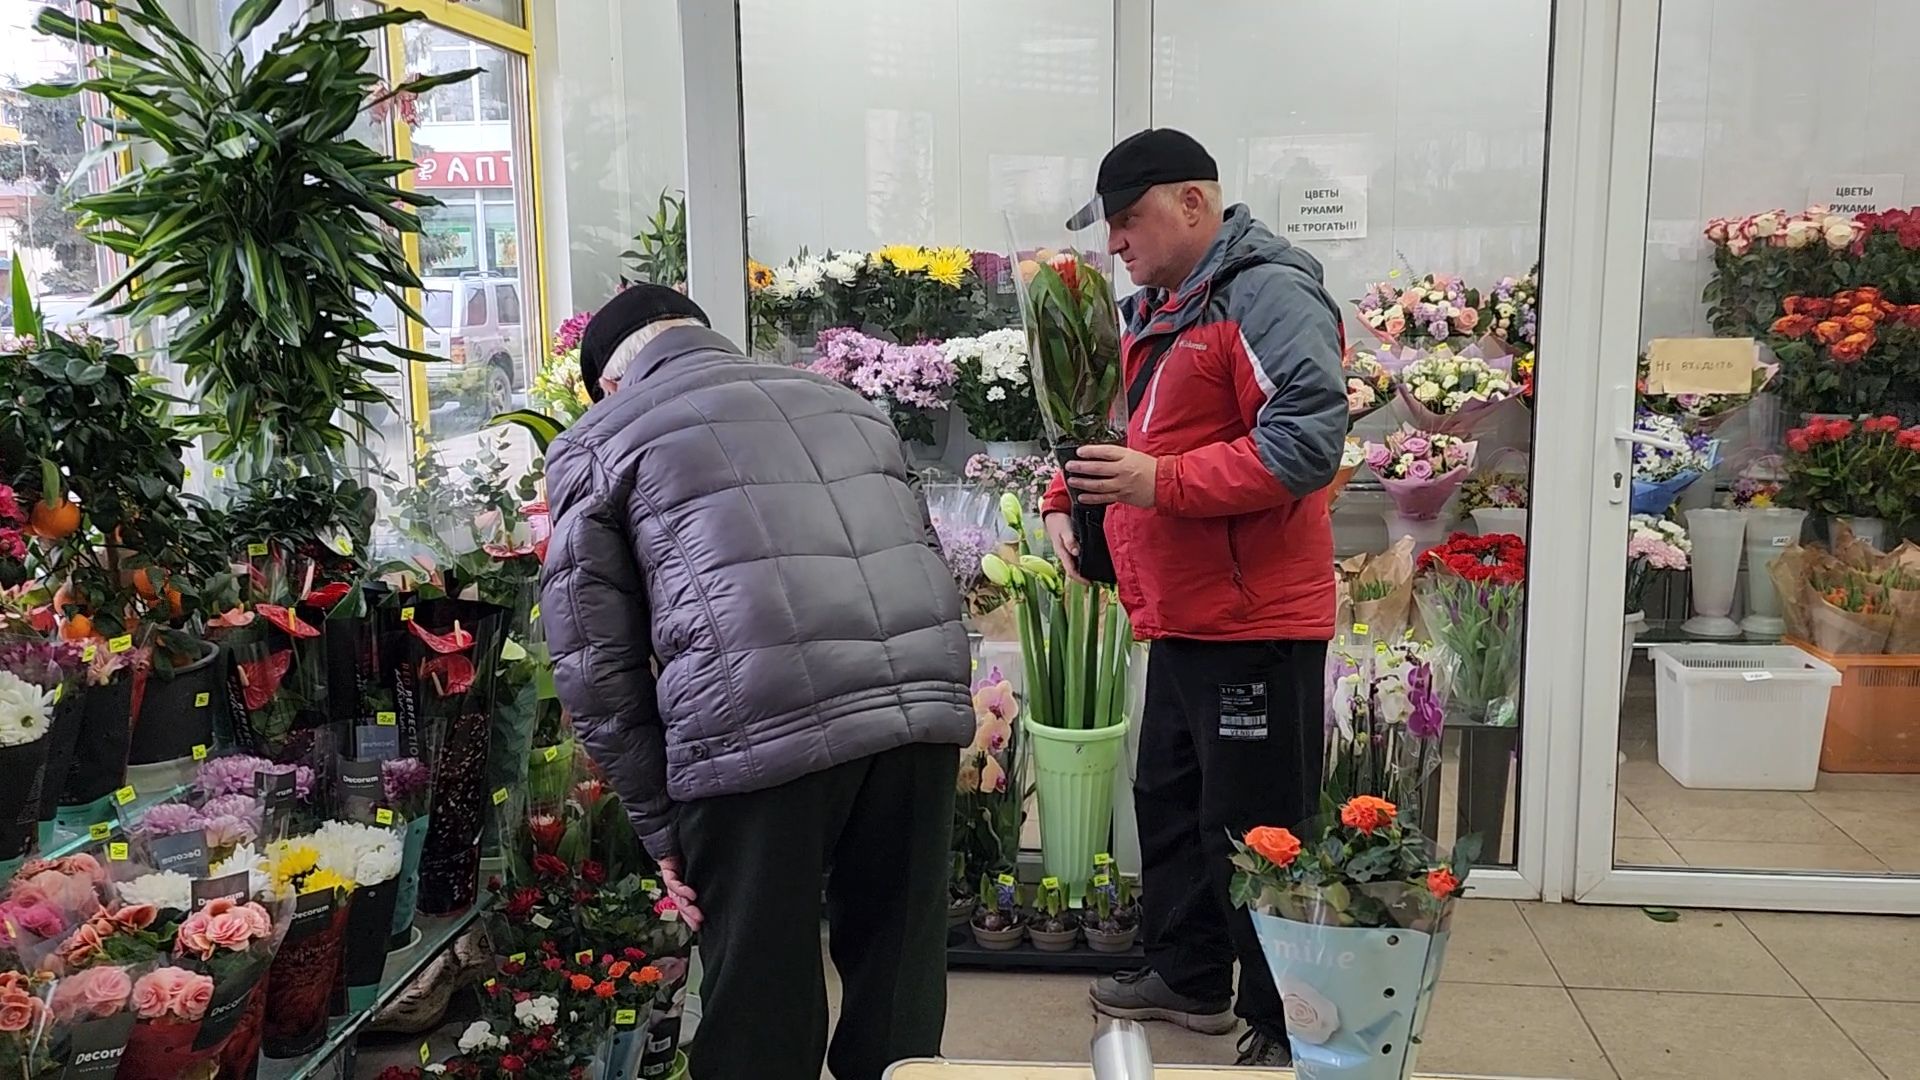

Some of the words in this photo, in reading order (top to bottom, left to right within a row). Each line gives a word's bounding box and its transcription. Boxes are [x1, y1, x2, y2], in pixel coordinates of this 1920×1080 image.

[1305, 189, 1339, 200] ЦВЕТЫ
[1836, 187, 1873, 198] ЦВЕТЫ
[1300, 205, 1343, 215] РУКАМИ
[1829, 204, 1876, 213] РУКАМИ
[1287, 224, 1300, 233] НЕ
[1303, 221, 1357, 232] ТРОГАТЬ!!!
[405, 690, 419, 757] PERFECTIO
[342, 775, 379, 784] Decorum
[290, 904, 330, 920] Decorum
[75, 1045, 127, 1066] Decoru
